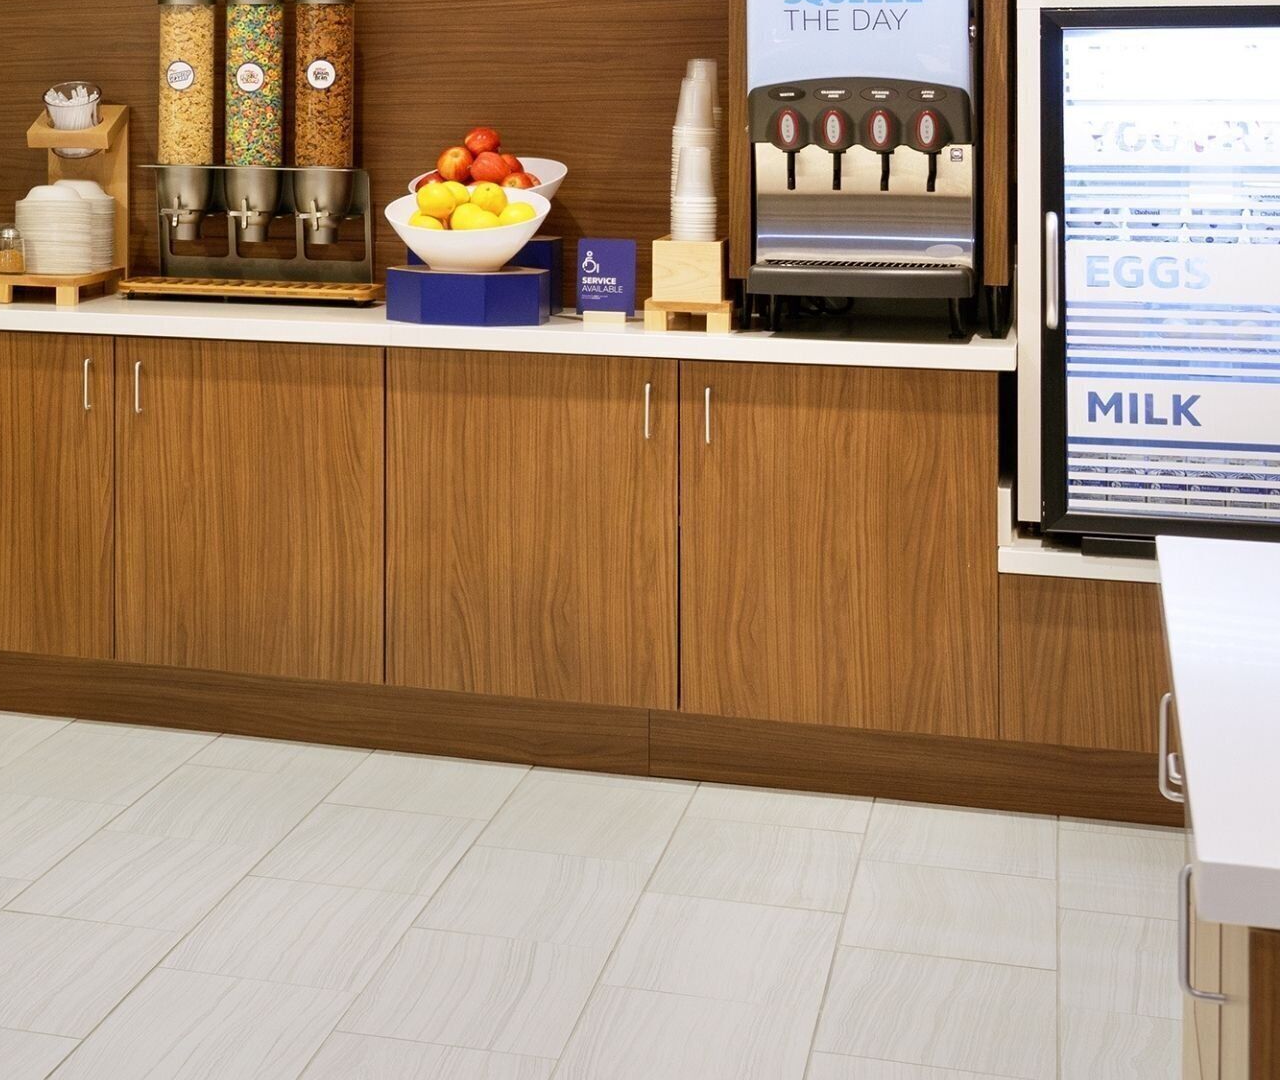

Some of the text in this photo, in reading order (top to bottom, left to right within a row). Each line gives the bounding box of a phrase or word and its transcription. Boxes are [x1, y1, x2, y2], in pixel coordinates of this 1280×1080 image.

[783, 8, 908, 31] THE DAY
[581, 276, 617, 285] SERVICE
[1085, 255, 1212, 290] EGGS
[581, 284, 624, 294] AVAILABLE
[1087, 391, 1202, 427] MILK
